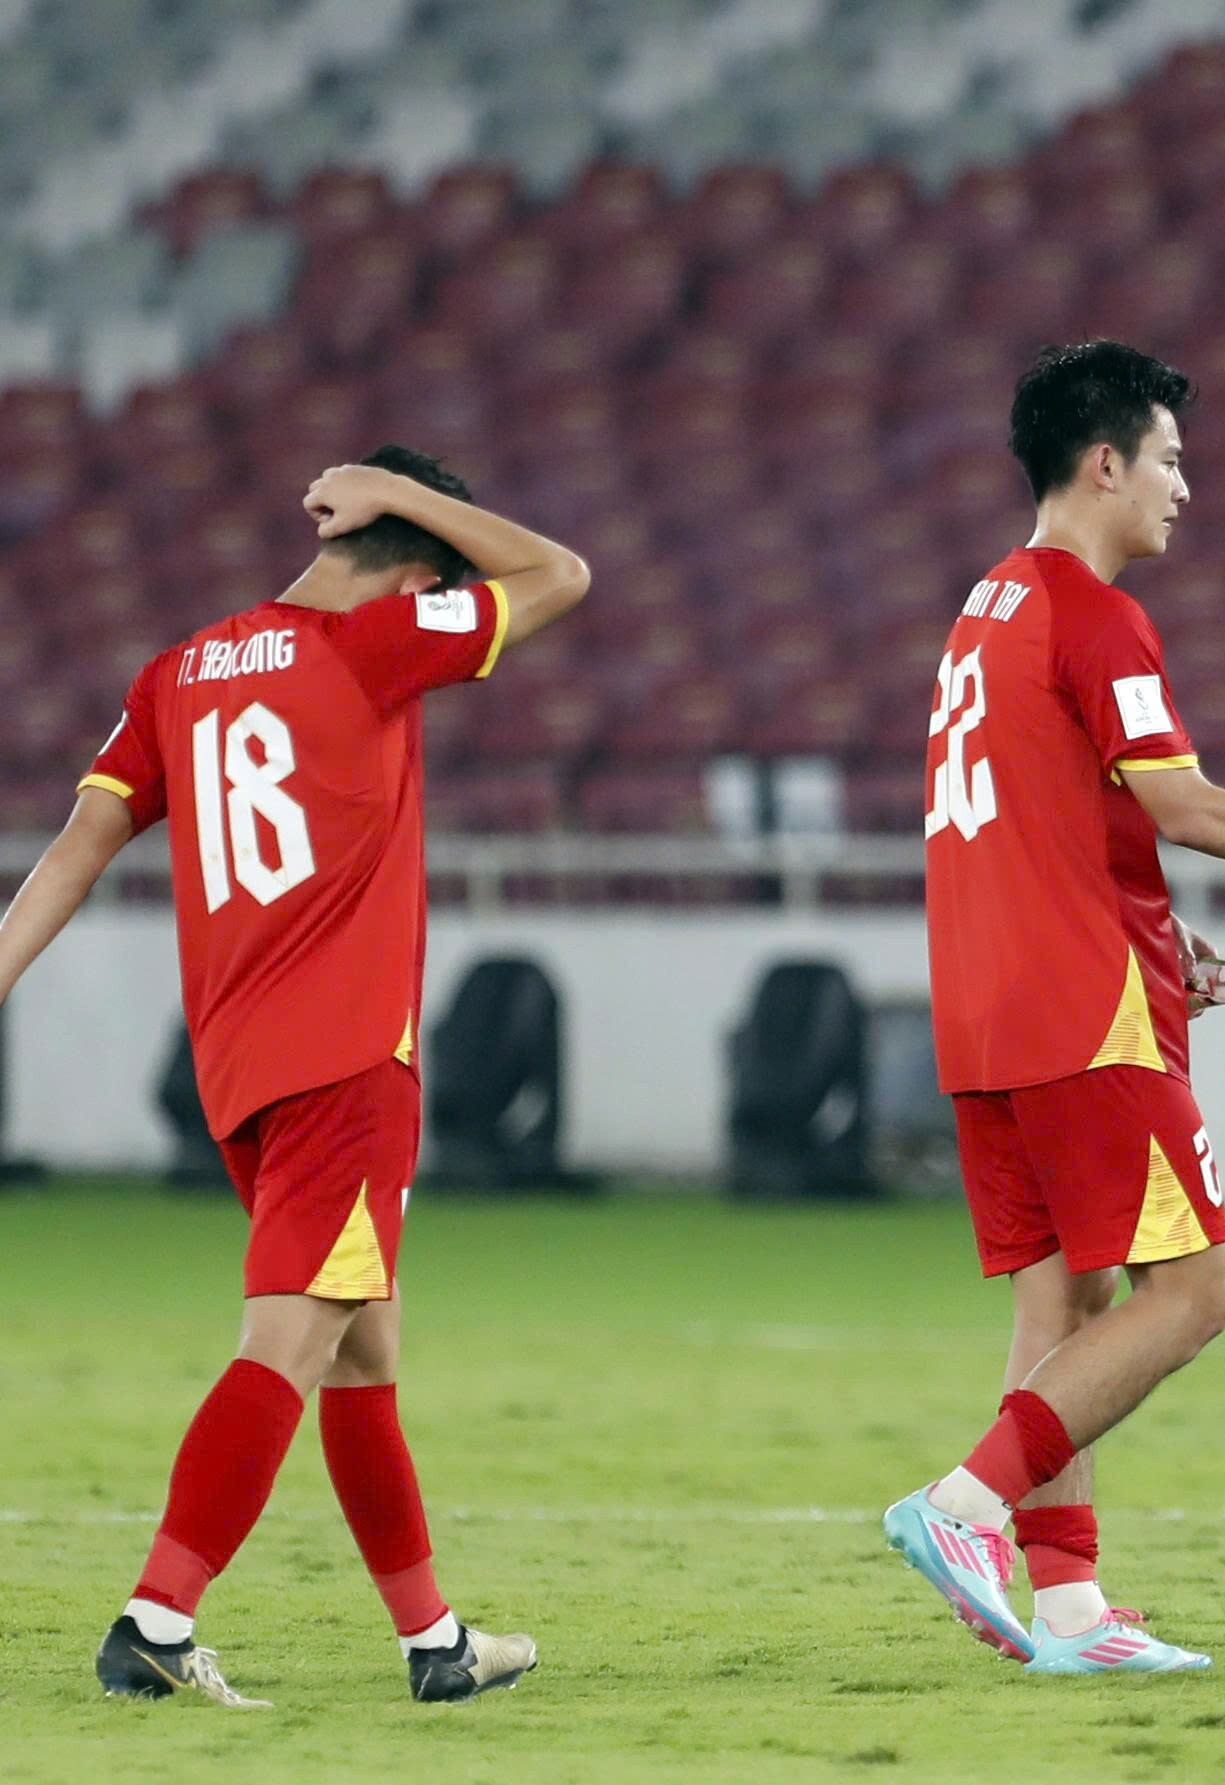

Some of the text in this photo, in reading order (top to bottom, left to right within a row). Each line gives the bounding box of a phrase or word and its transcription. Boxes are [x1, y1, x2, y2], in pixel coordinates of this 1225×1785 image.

[957, 579, 1032, 622] AN TAI
[192, 701, 316, 914] 18
[925, 644, 997, 842] 22
[1193, 1125, 1223, 1208] 2
